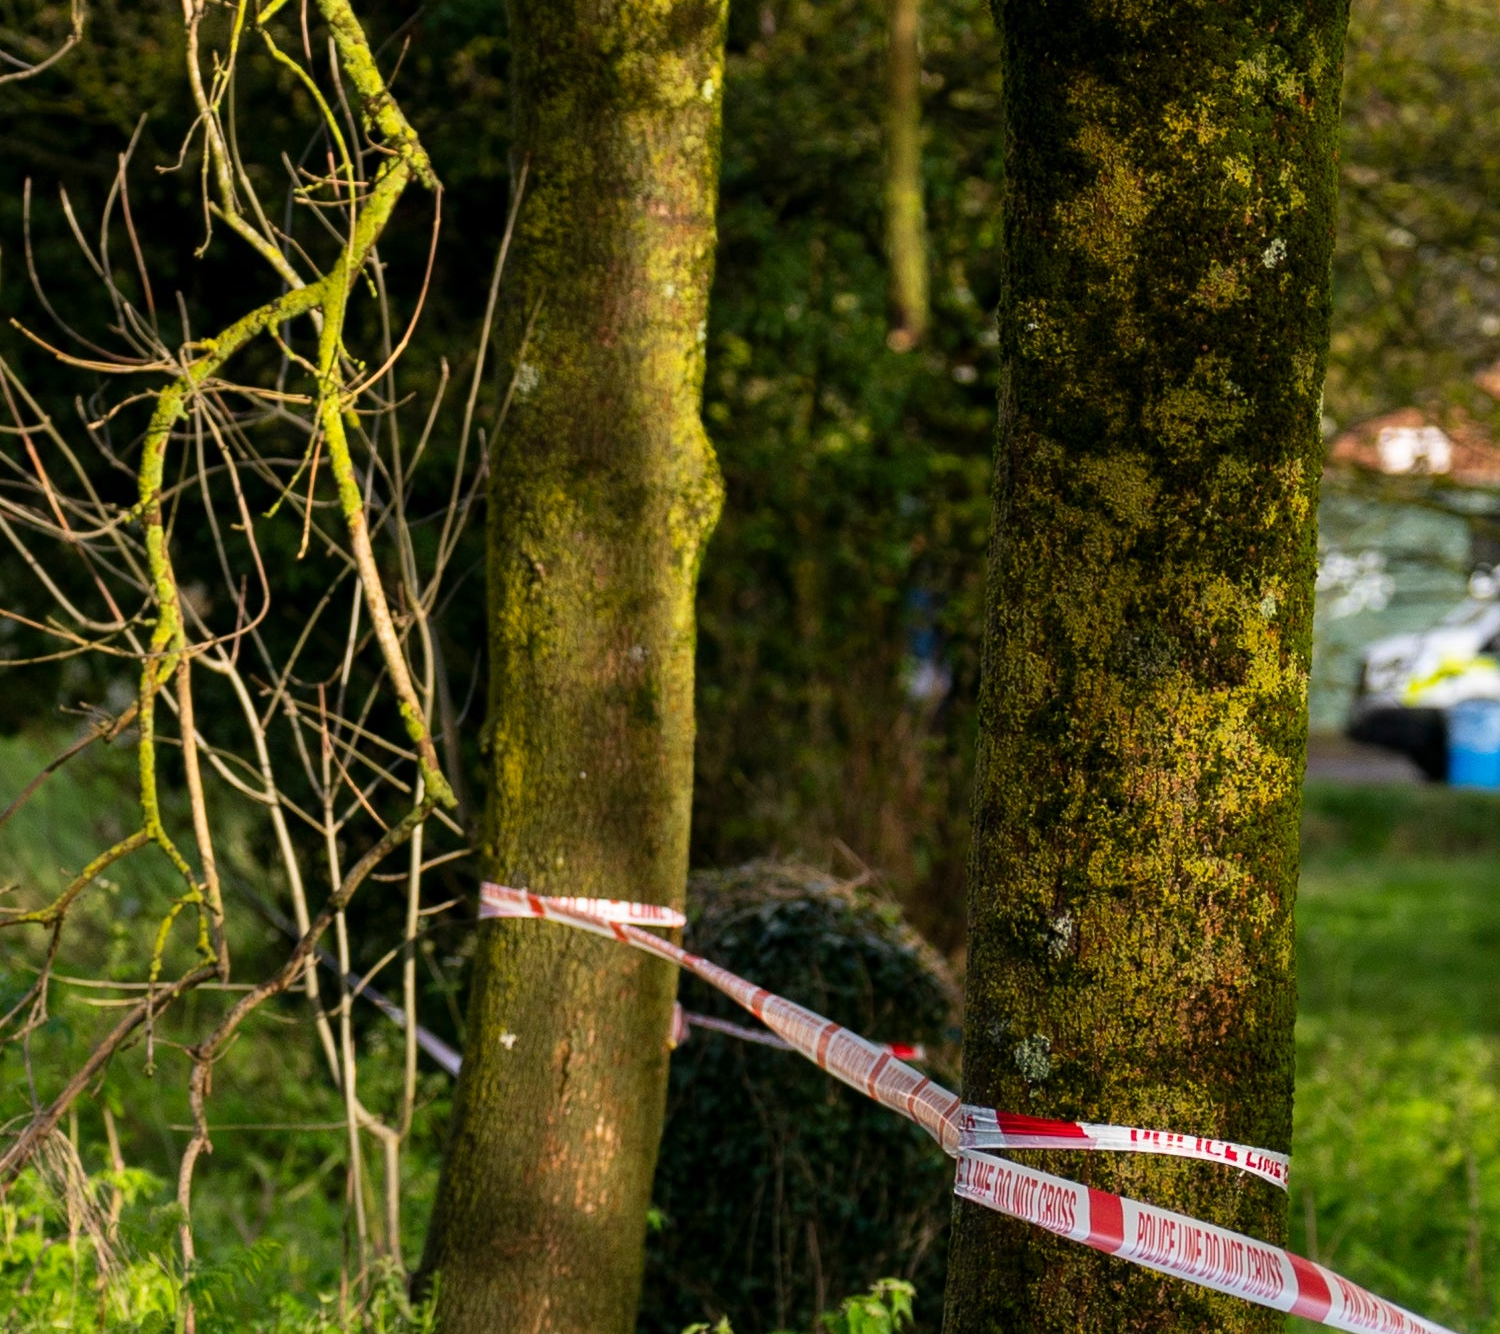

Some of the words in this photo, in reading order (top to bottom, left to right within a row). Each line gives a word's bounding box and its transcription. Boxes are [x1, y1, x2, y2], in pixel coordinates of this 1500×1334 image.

[966, 1158, 995, 1197] LINE
[994, 1168, 1012, 1209] DO
[1013, 1174, 1038, 1220] NOT
[1038, 1182, 1077, 1234] CROSS
[1129, 1211, 1176, 1266] POLICE
[1170, 1223, 1202, 1275] LINE
[1197, 1231, 1221, 1280] DO
[1216, 1236, 1243, 1288] NOT
[1241, 1244, 1284, 1301] CROSS
